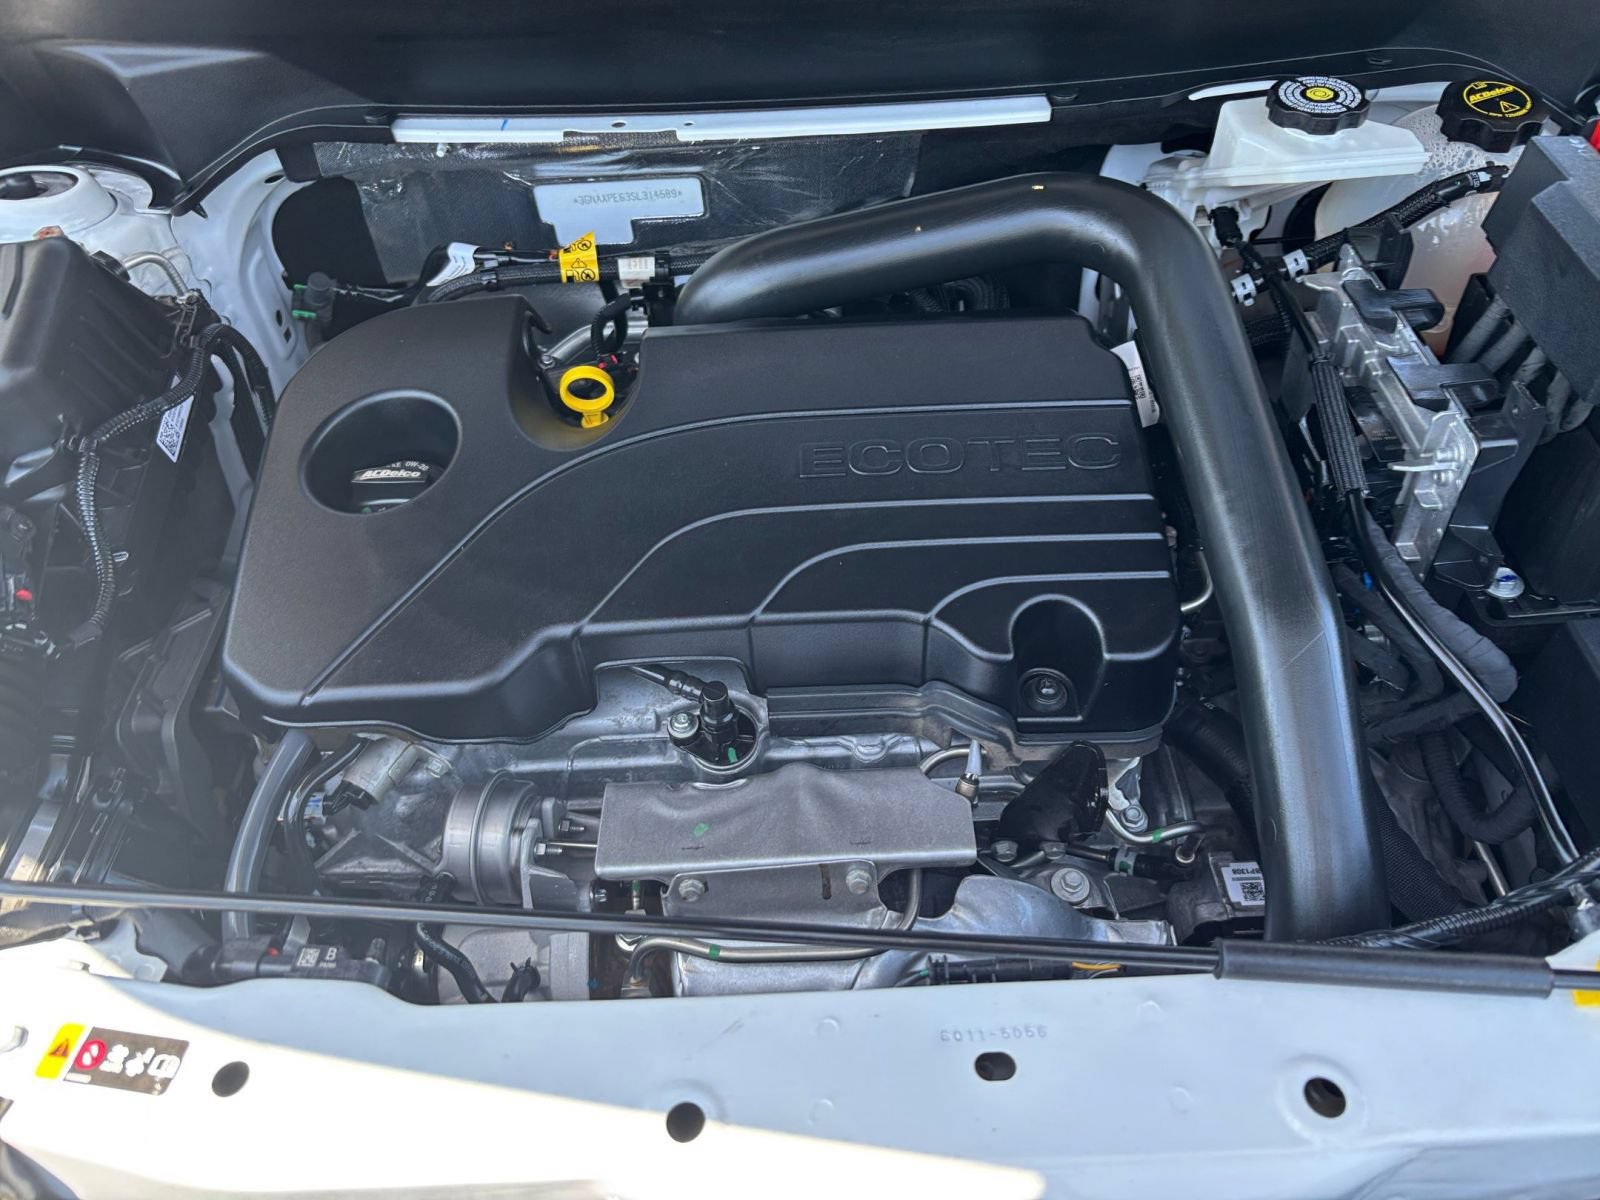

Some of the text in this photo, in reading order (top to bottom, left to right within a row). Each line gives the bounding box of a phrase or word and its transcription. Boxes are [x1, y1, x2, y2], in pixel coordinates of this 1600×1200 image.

[1469, 86, 1514, 103] ACDelco
[799, 432, 1120, 478] ECOTEC
[405, 460, 429, 472] 0W-20
[360, 469, 421, 480] ACDelco
[325, 947, 338, 961] B
